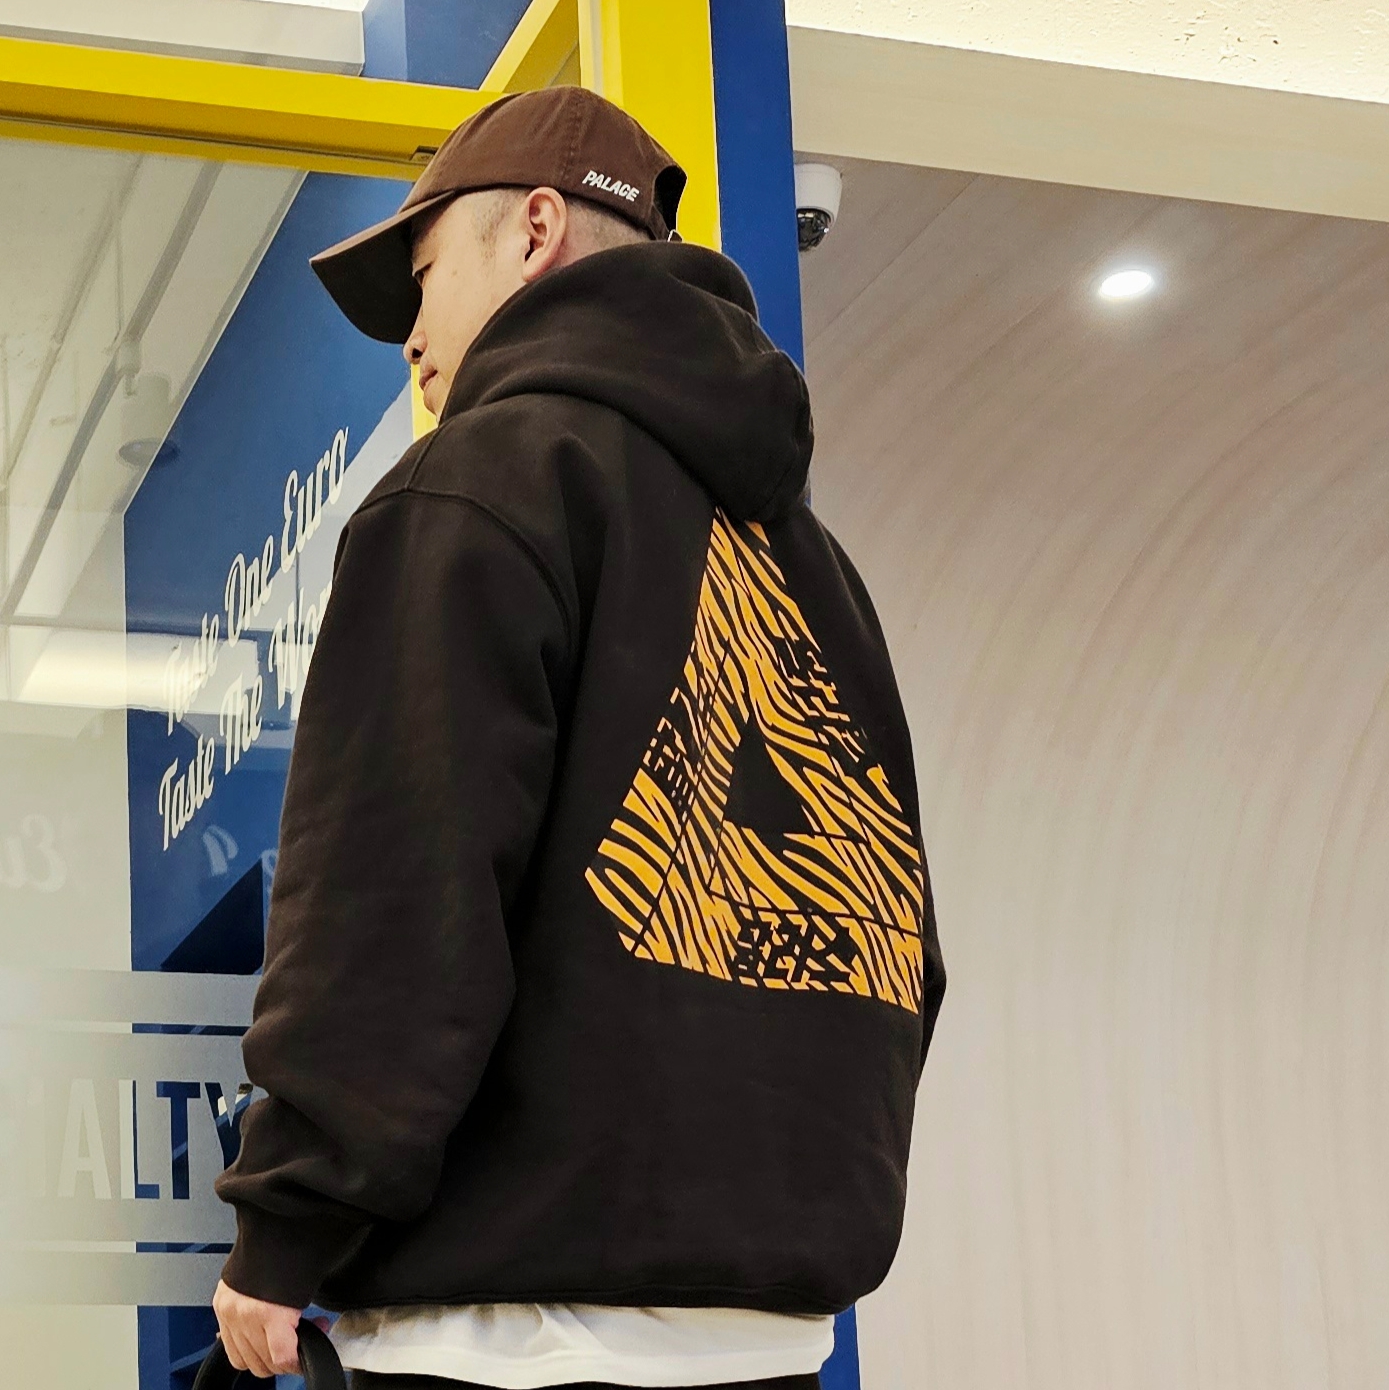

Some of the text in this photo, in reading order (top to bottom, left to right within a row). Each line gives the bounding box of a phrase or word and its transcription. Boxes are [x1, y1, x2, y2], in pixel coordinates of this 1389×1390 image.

[582, 170, 640, 202] PALACE
[163, 426, 349, 736] Taste One Euro
[158, 733, 215, 851] Taste
[219, 672, 263, 775] The
